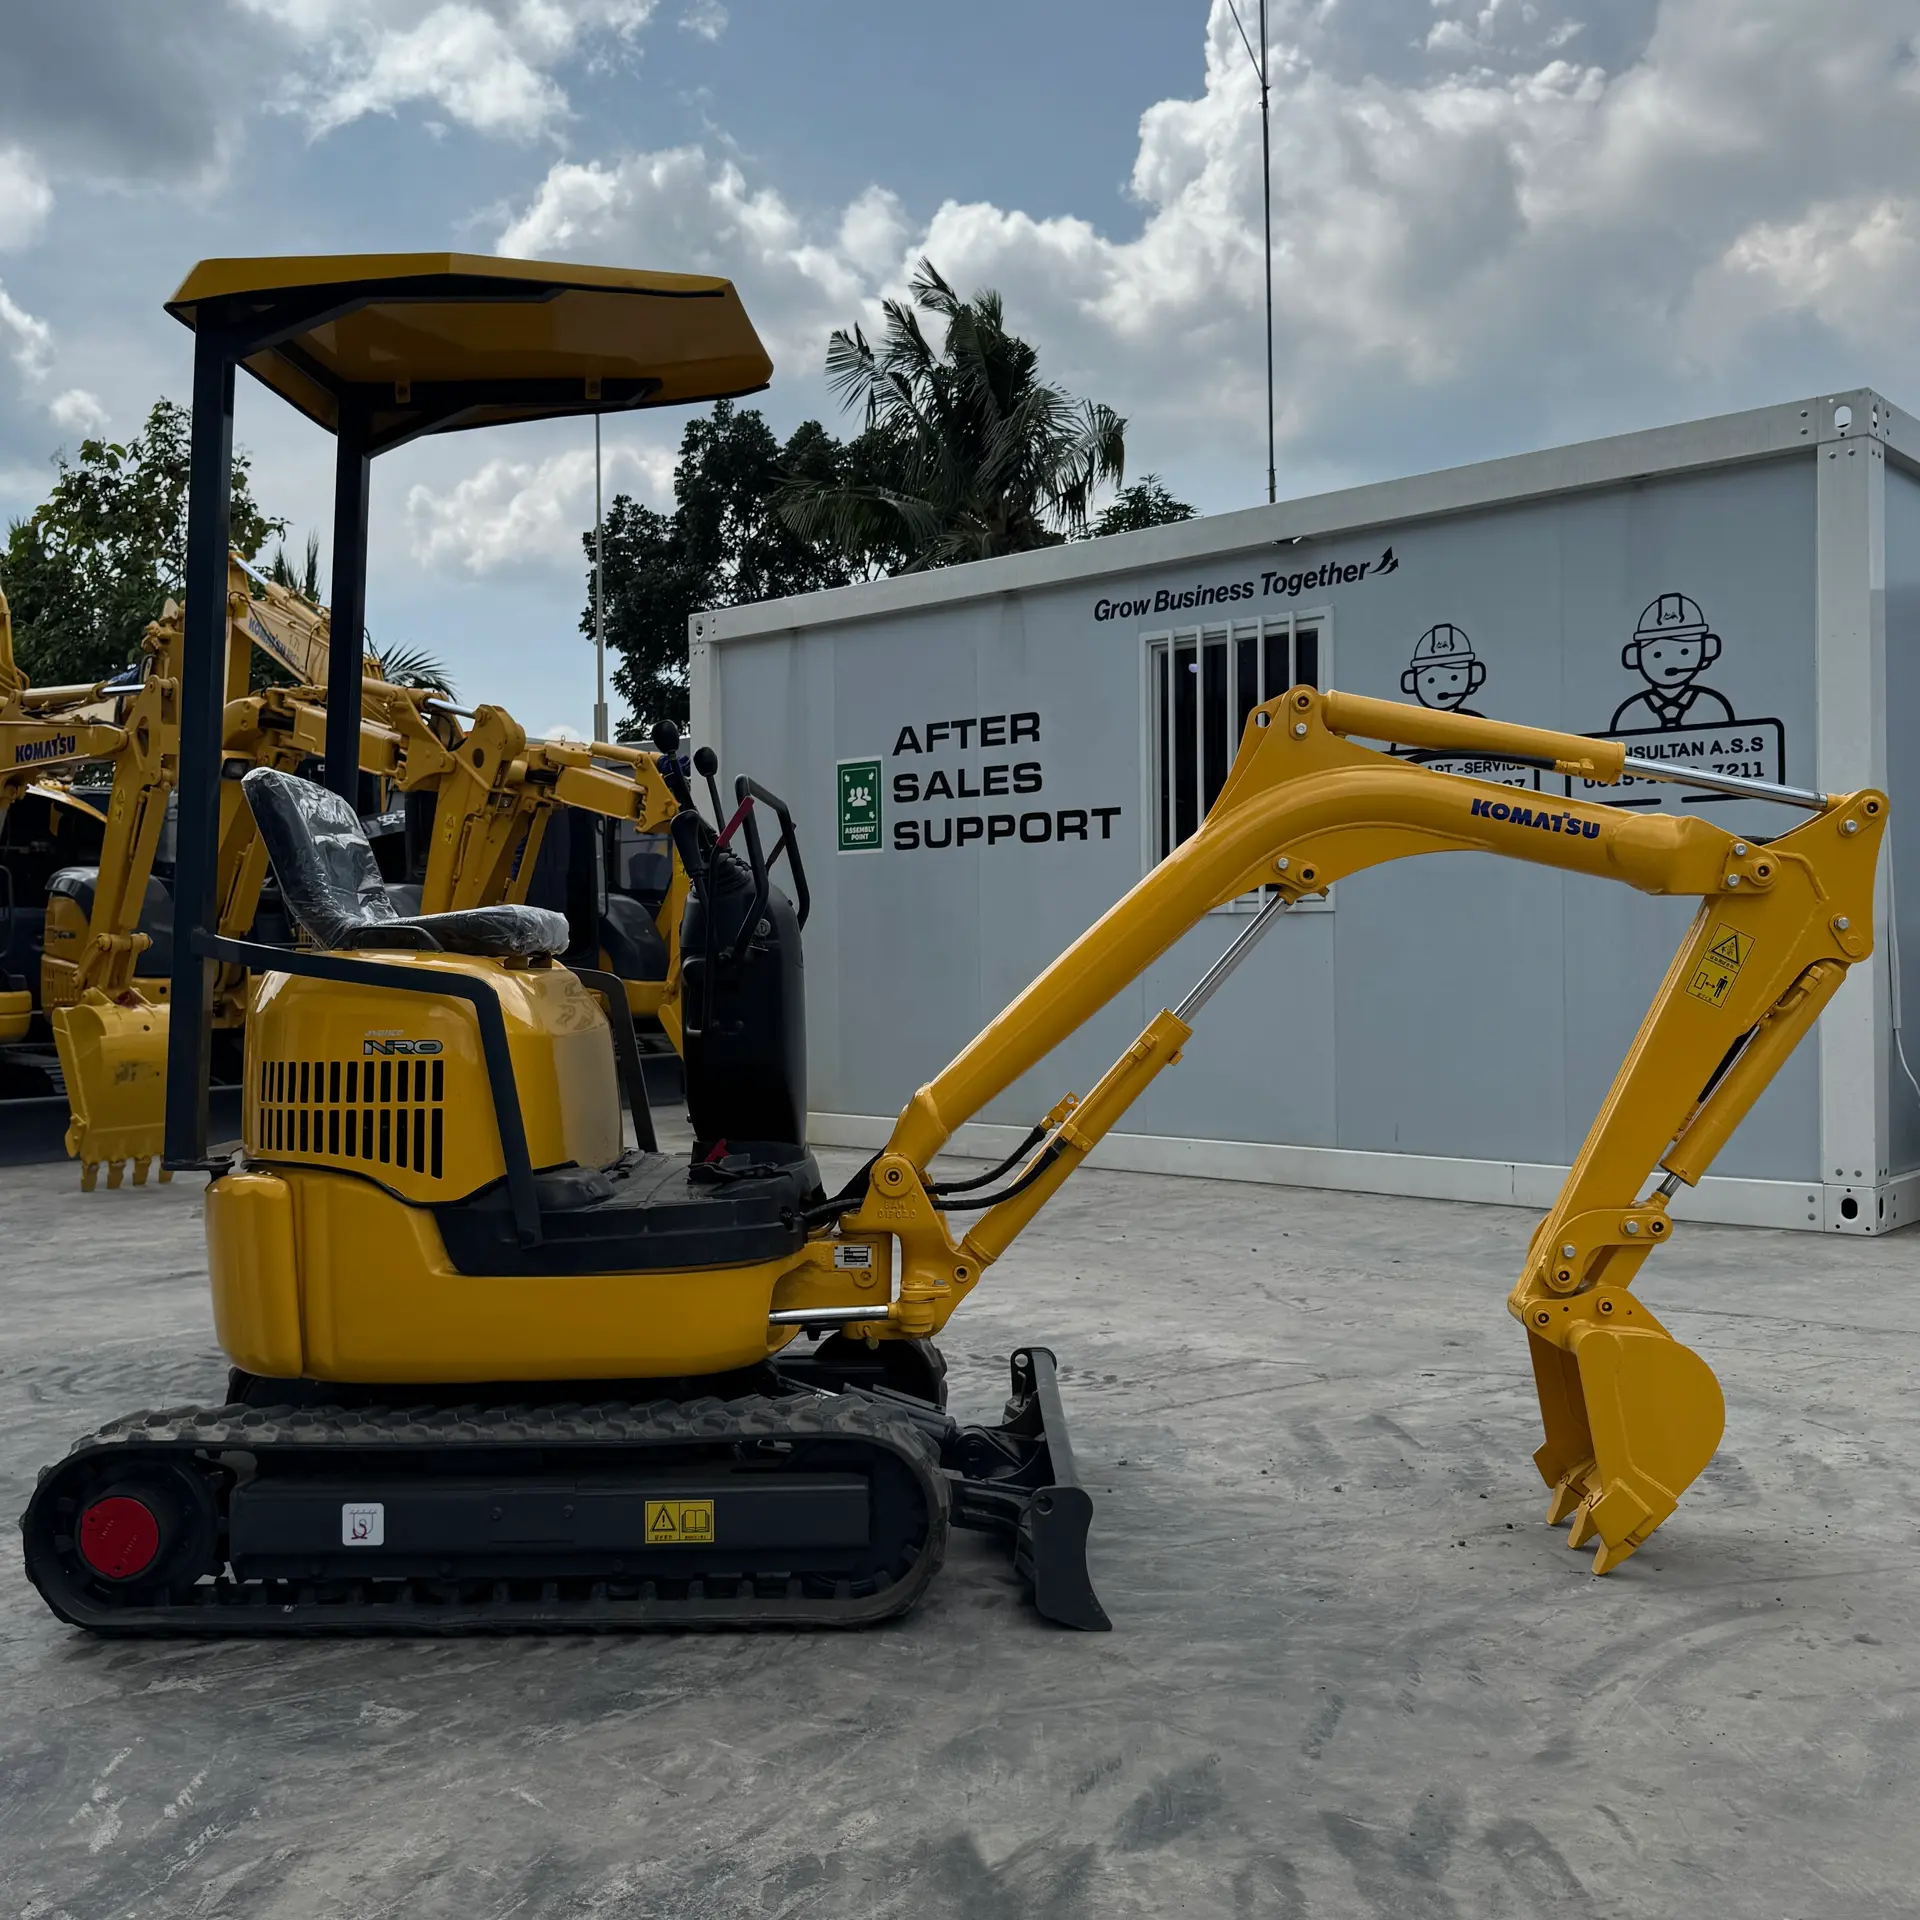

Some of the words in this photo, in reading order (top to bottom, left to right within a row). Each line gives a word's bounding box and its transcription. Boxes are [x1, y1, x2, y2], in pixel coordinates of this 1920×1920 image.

[1094, 598, 1151, 622] Grow
[1153, 581, 1255, 613] Business
[1260, 561, 1372, 597] Together
[15, 732, 76, 763] KOMATSU
[892, 711, 1041, 756] AFTER
[1710, 736, 1764, 756] A.S.S
[892, 761, 1043, 803] SALES
[844, 825, 875, 834] ASSEMBLY
[893, 806, 1122, 850] SUPPORT
[1470, 798, 1600, 839] KOMATSU
[851, 833, 869, 841] POINT
[363, 1039, 443, 1055] NRO
